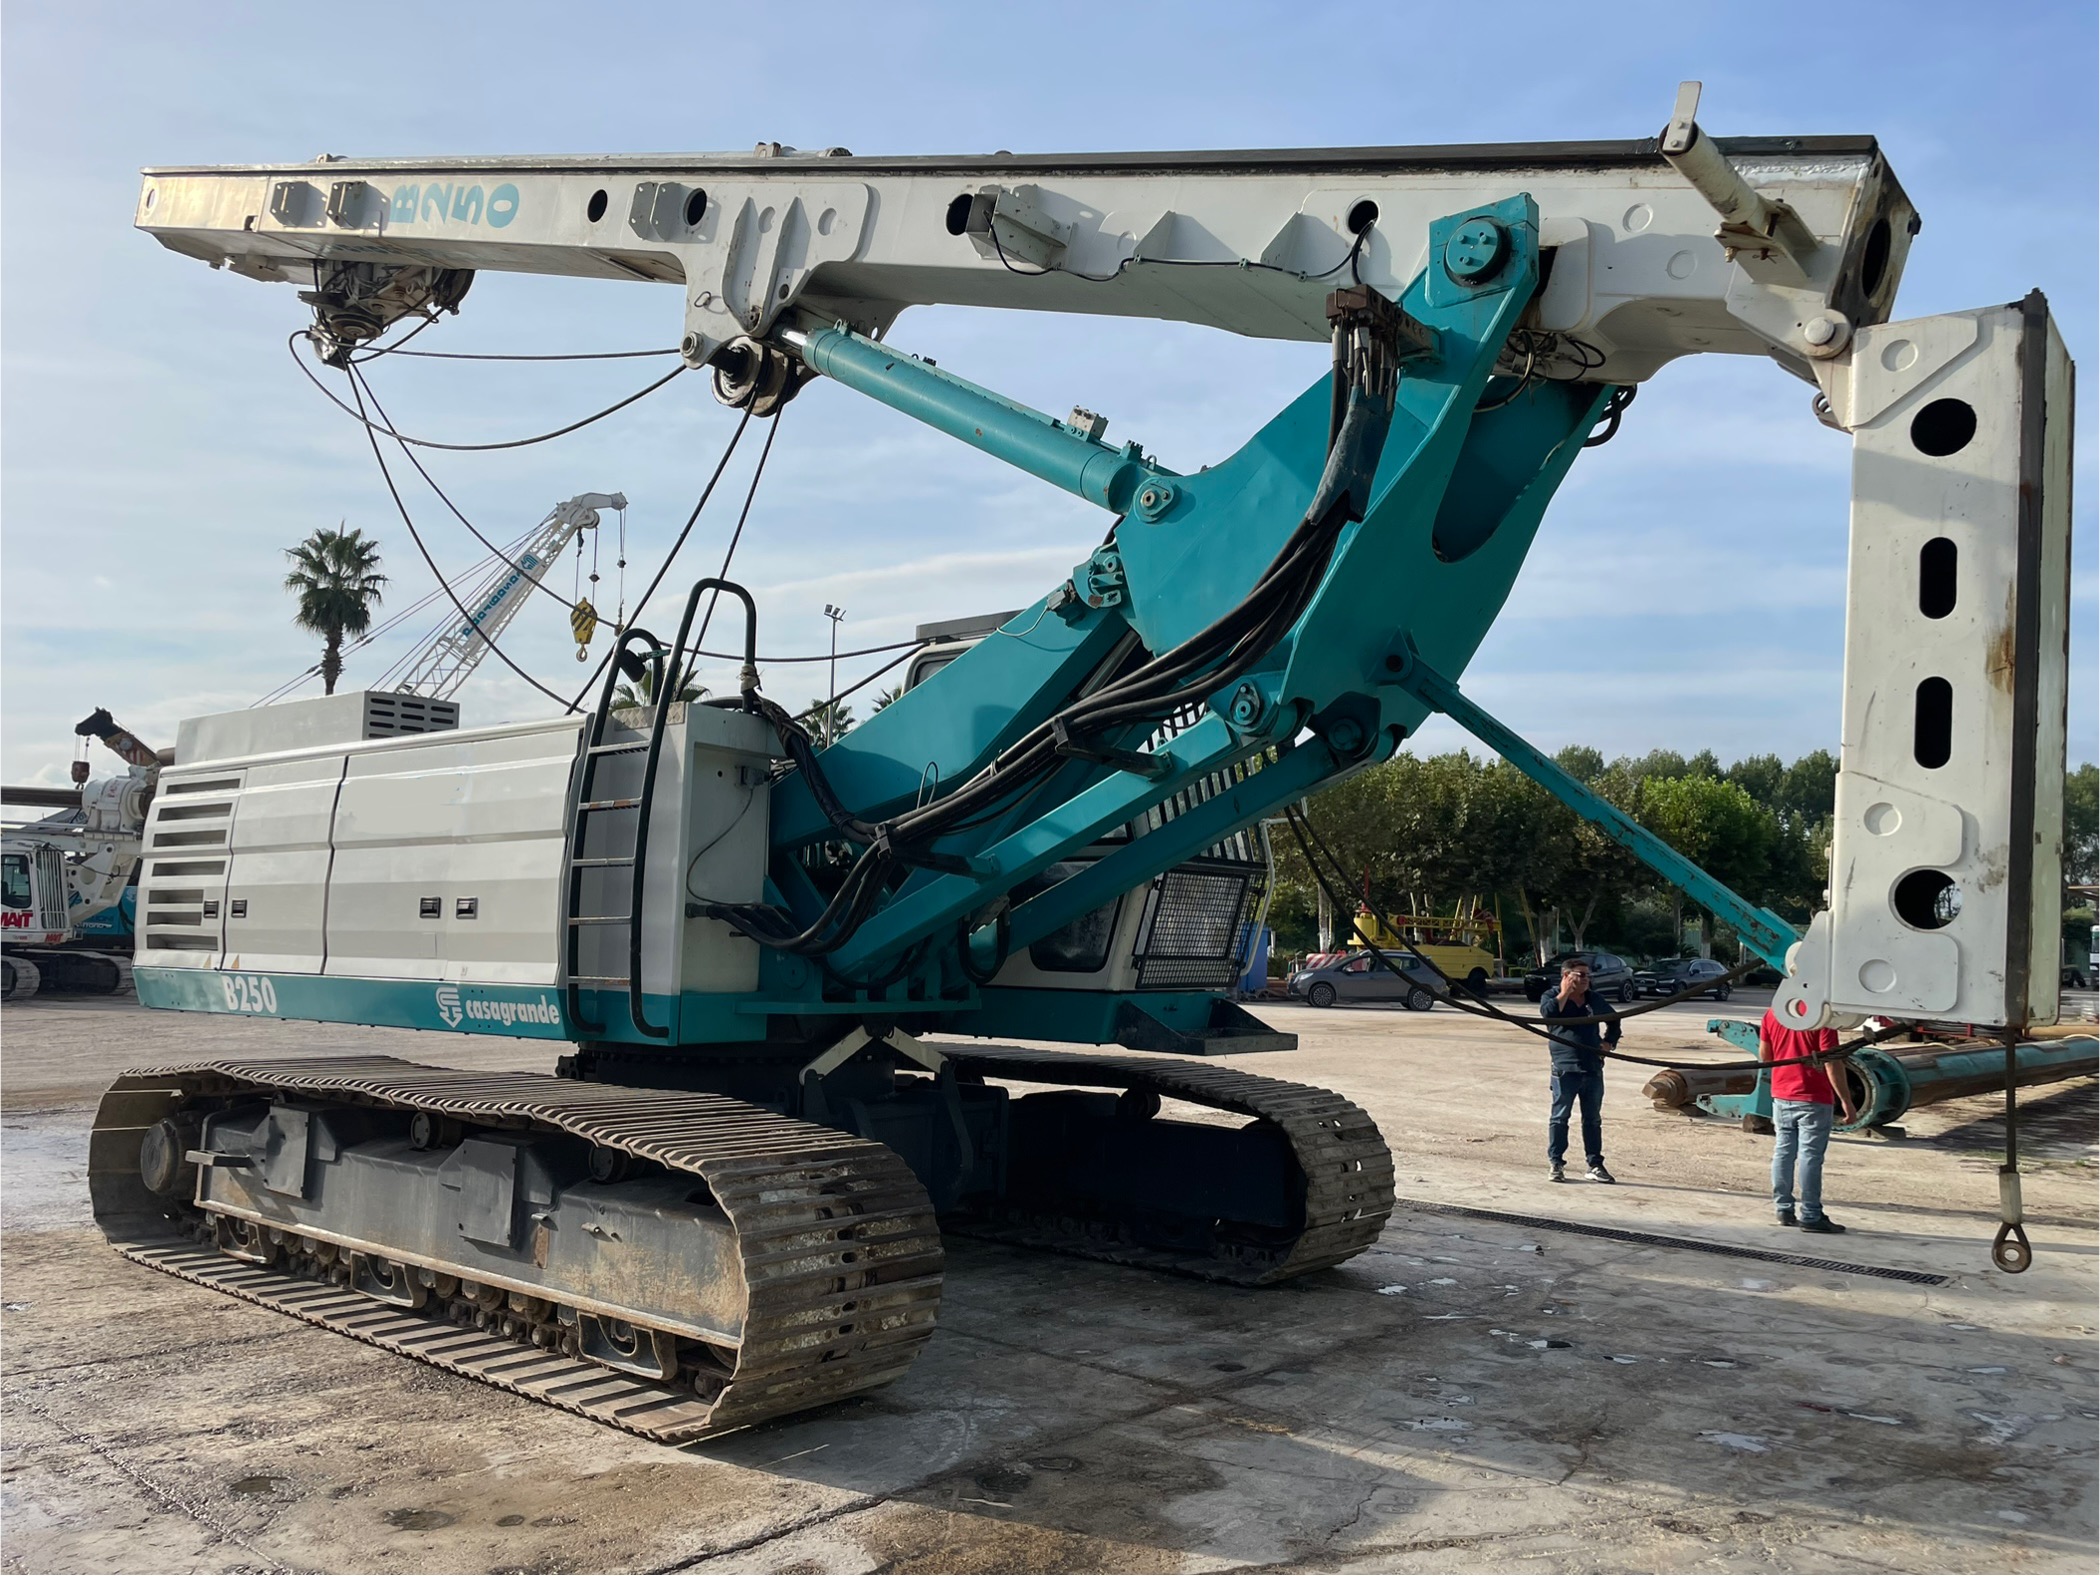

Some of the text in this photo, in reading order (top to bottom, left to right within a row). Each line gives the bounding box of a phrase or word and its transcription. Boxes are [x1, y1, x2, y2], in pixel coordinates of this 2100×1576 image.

[389, 182, 520, 229] B250
[221, 975, 277, 1014] B250
[465, 994, 560, 1027] casagrande
